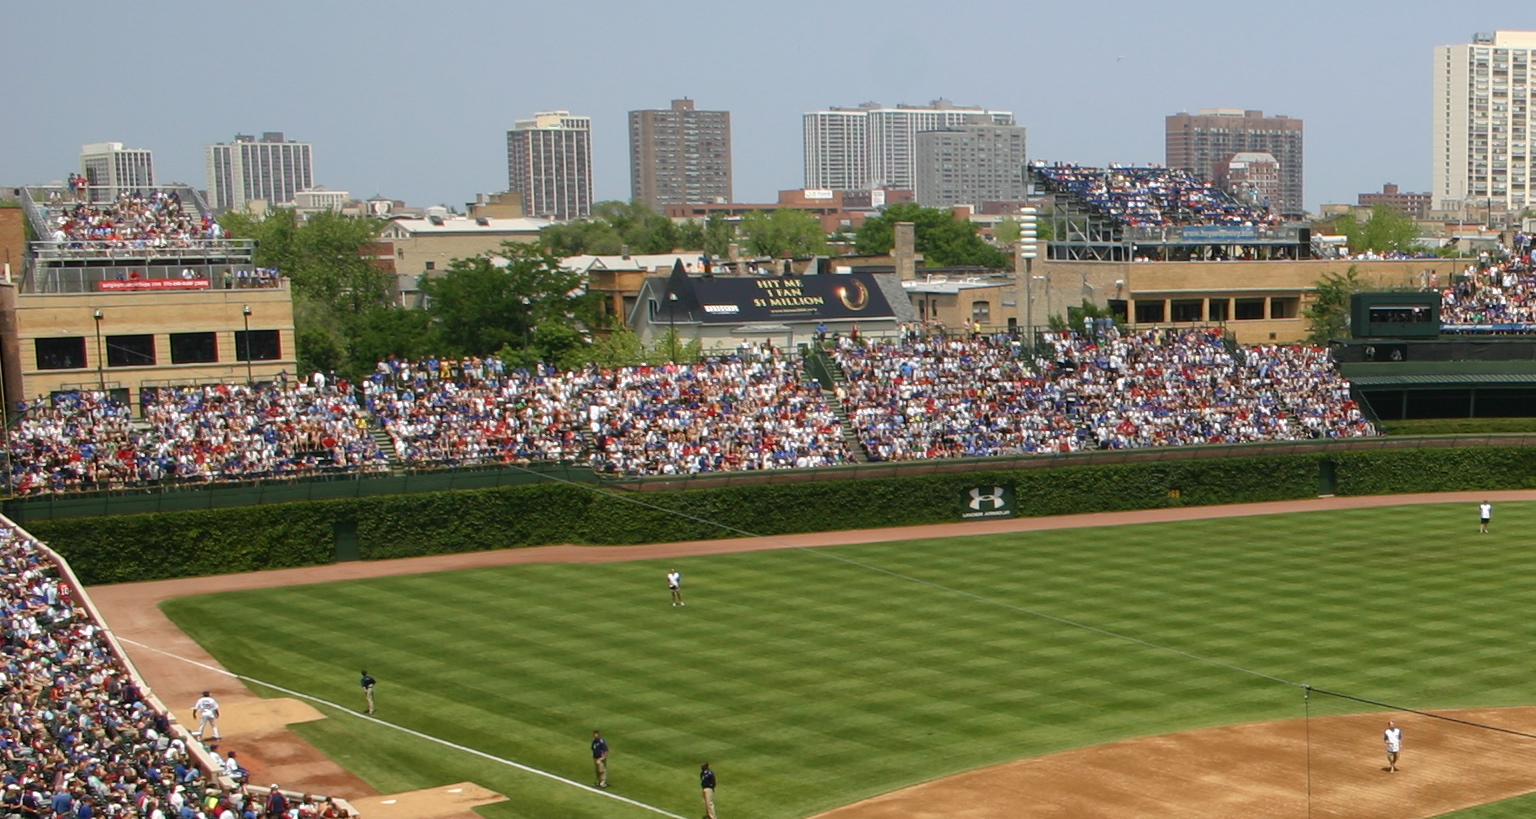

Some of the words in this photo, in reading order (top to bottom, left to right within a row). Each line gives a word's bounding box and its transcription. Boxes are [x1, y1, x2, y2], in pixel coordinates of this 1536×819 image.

[757, 280, 780, 288] HIT
[784, 279, 803, 288] ME
[778, 288, 802, 297] FAN
[753, 299, 766, 307] $1
[771, 296, 824, 306] MILLION
